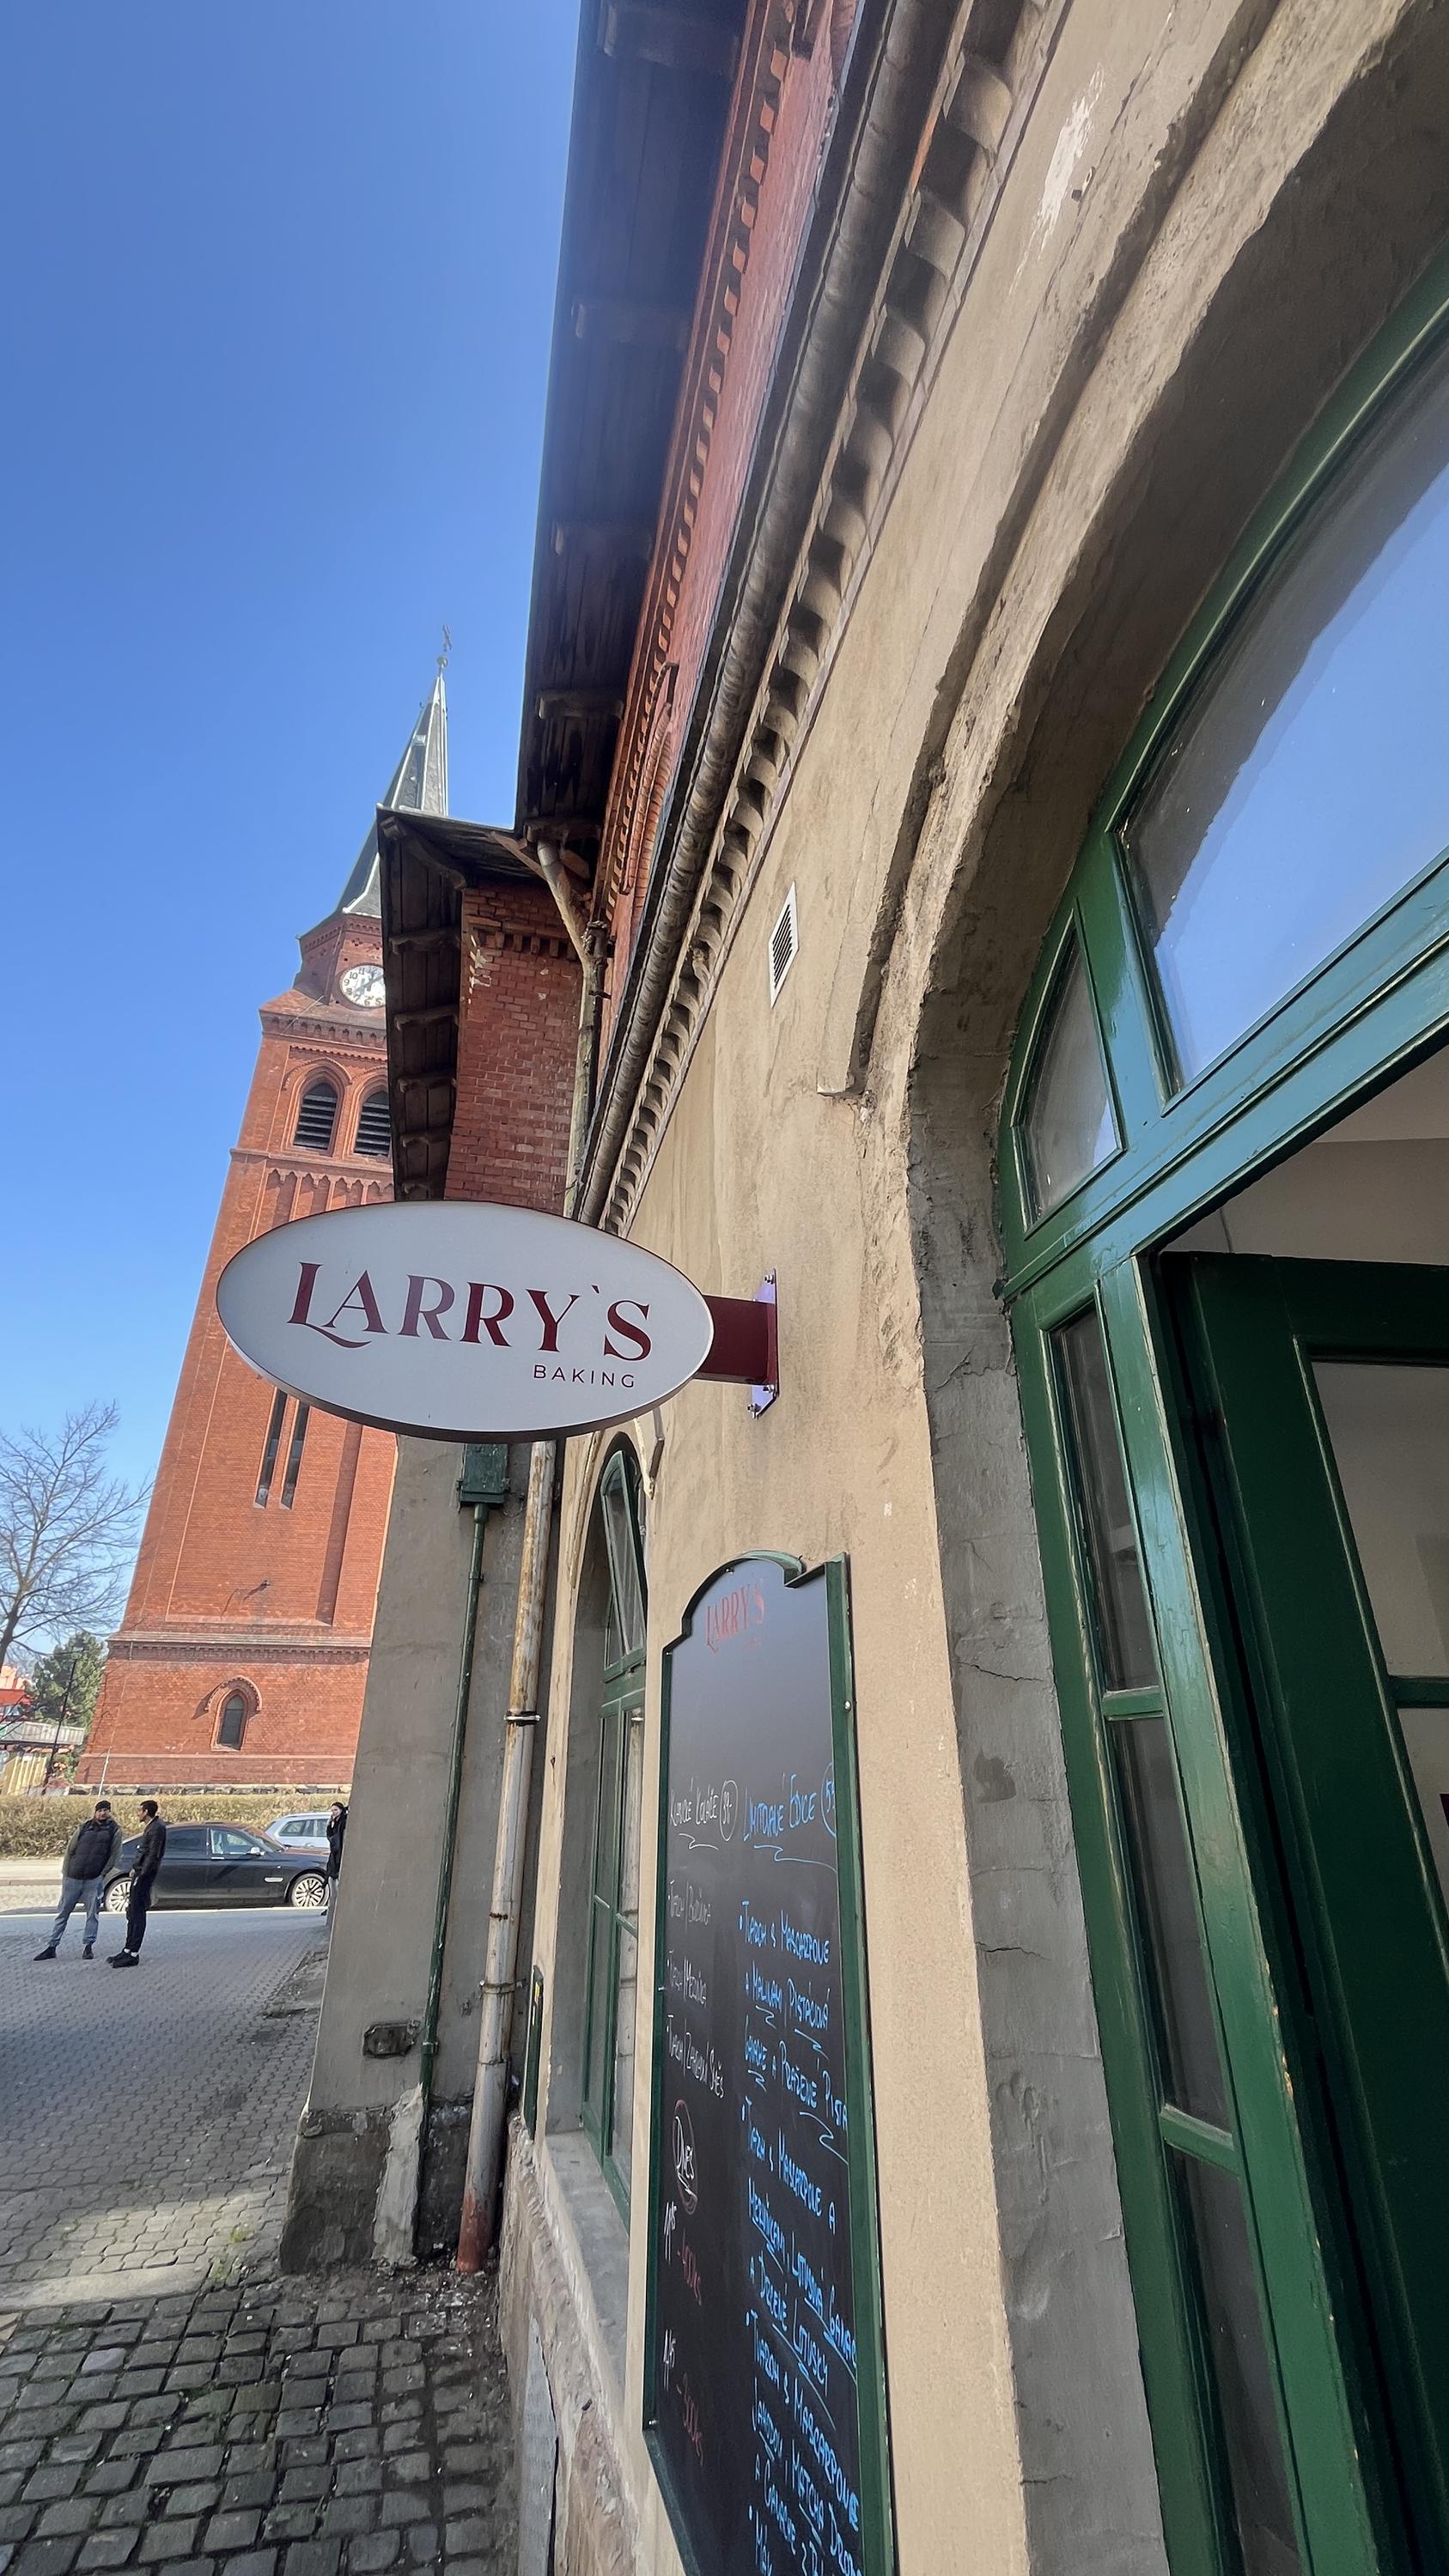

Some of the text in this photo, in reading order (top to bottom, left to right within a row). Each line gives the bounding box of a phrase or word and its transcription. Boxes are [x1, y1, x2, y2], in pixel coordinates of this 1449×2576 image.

[350, 971, 358, 980] 10
[533, 1364, 636, 1388] BAKING
[706, 1578, 766, 1656] LARRYS
[828, 2202, 837, 2236] A
[749, 2256, 755, 2285] A
[783, 2371, 790, 2404] S
[794, 2377, 859, 2532] MASCARPONE
[755, 2453, 761, 2482] A
[792, 2439, 825, 2531] MATCHA
